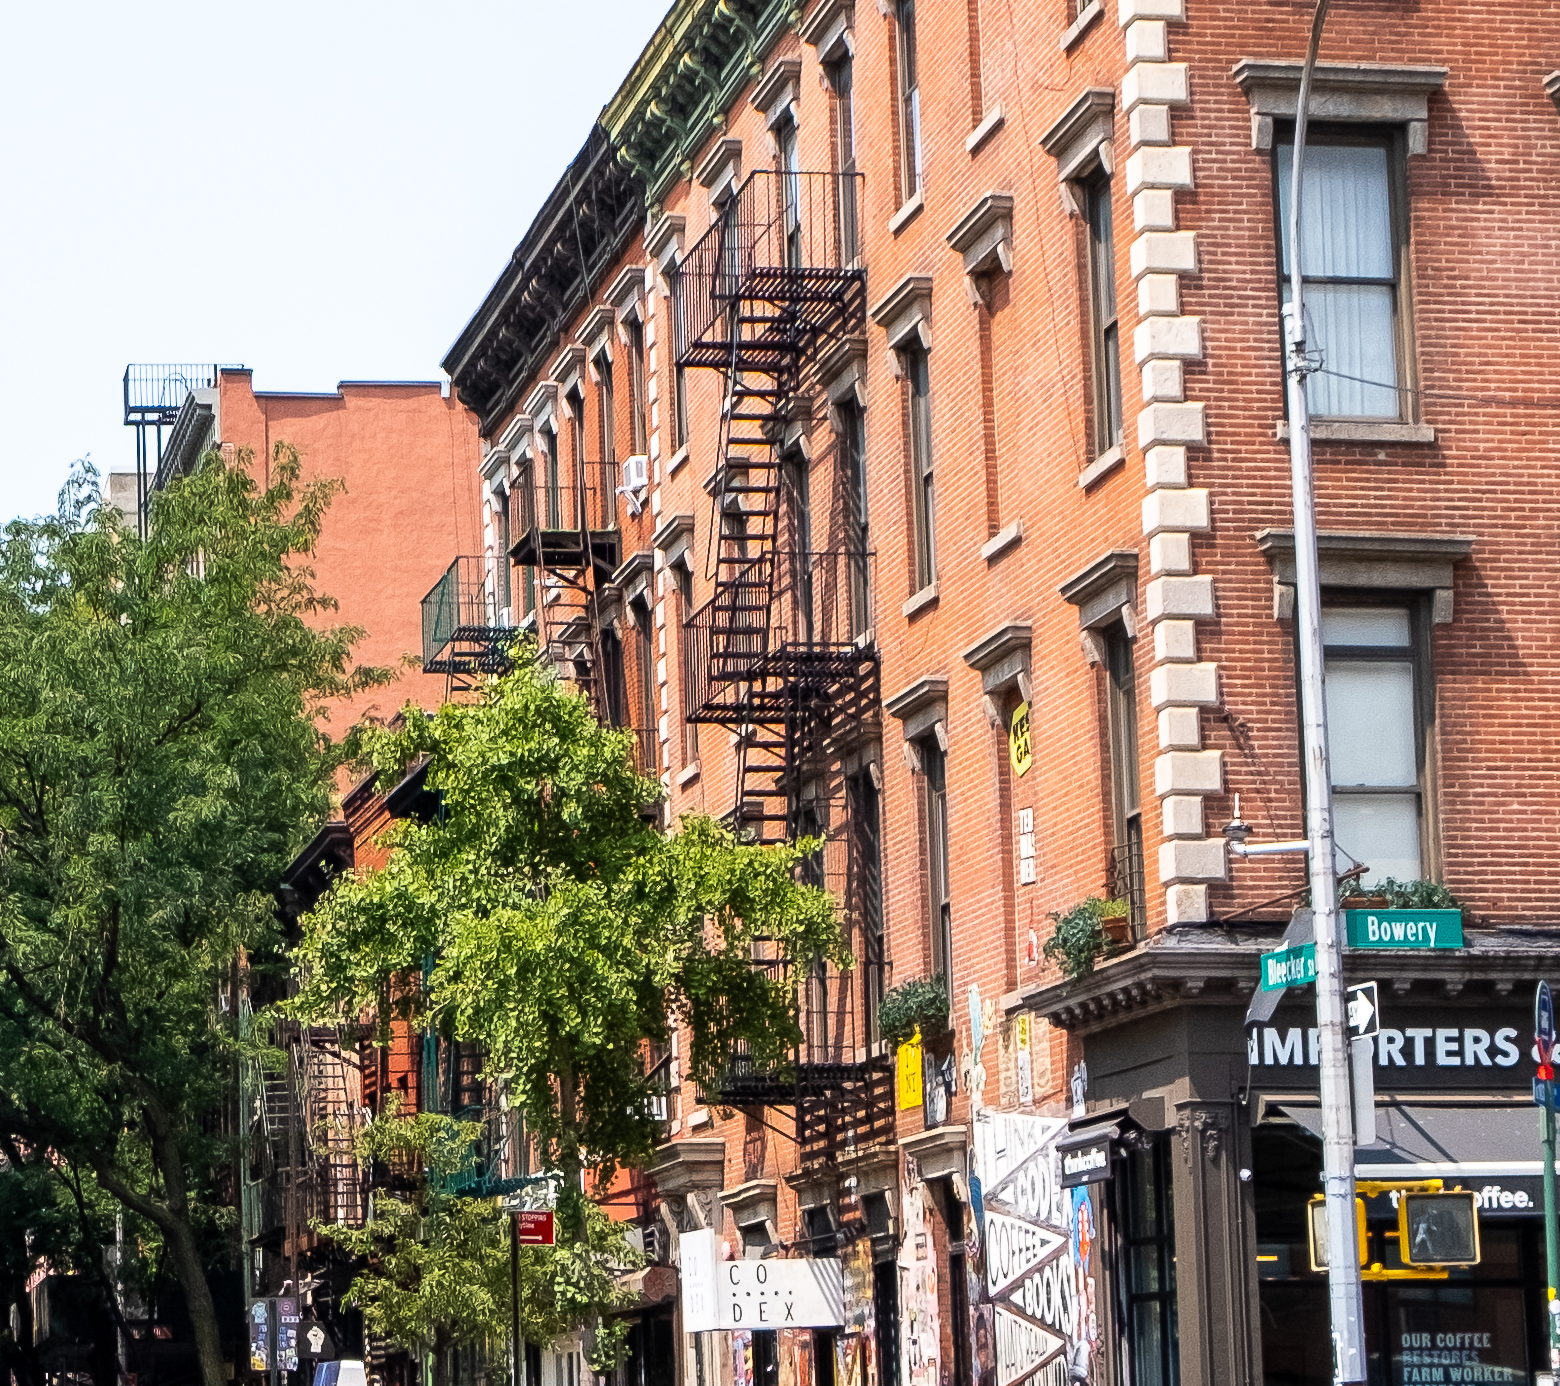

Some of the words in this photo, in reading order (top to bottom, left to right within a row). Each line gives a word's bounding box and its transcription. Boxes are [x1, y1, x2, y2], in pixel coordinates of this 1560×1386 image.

[1367, 915, 1437, 948] Bowery
[1267, 955, 1305, 986] Bleecker
[1247, 1026, 1521, 1067] IMRTERS
[988, 1218, 1038, 1287] COFFEE
[1402, 1333, 1431, 1348] OUR
[1436, 1333, 1492, 1348] COFFEE
[1403, 1350, 1481, 1365] RESTORES
[1403, 1367, 1444, 1382] FARM
[1449, 1367, 1513, 1382] WORKER
